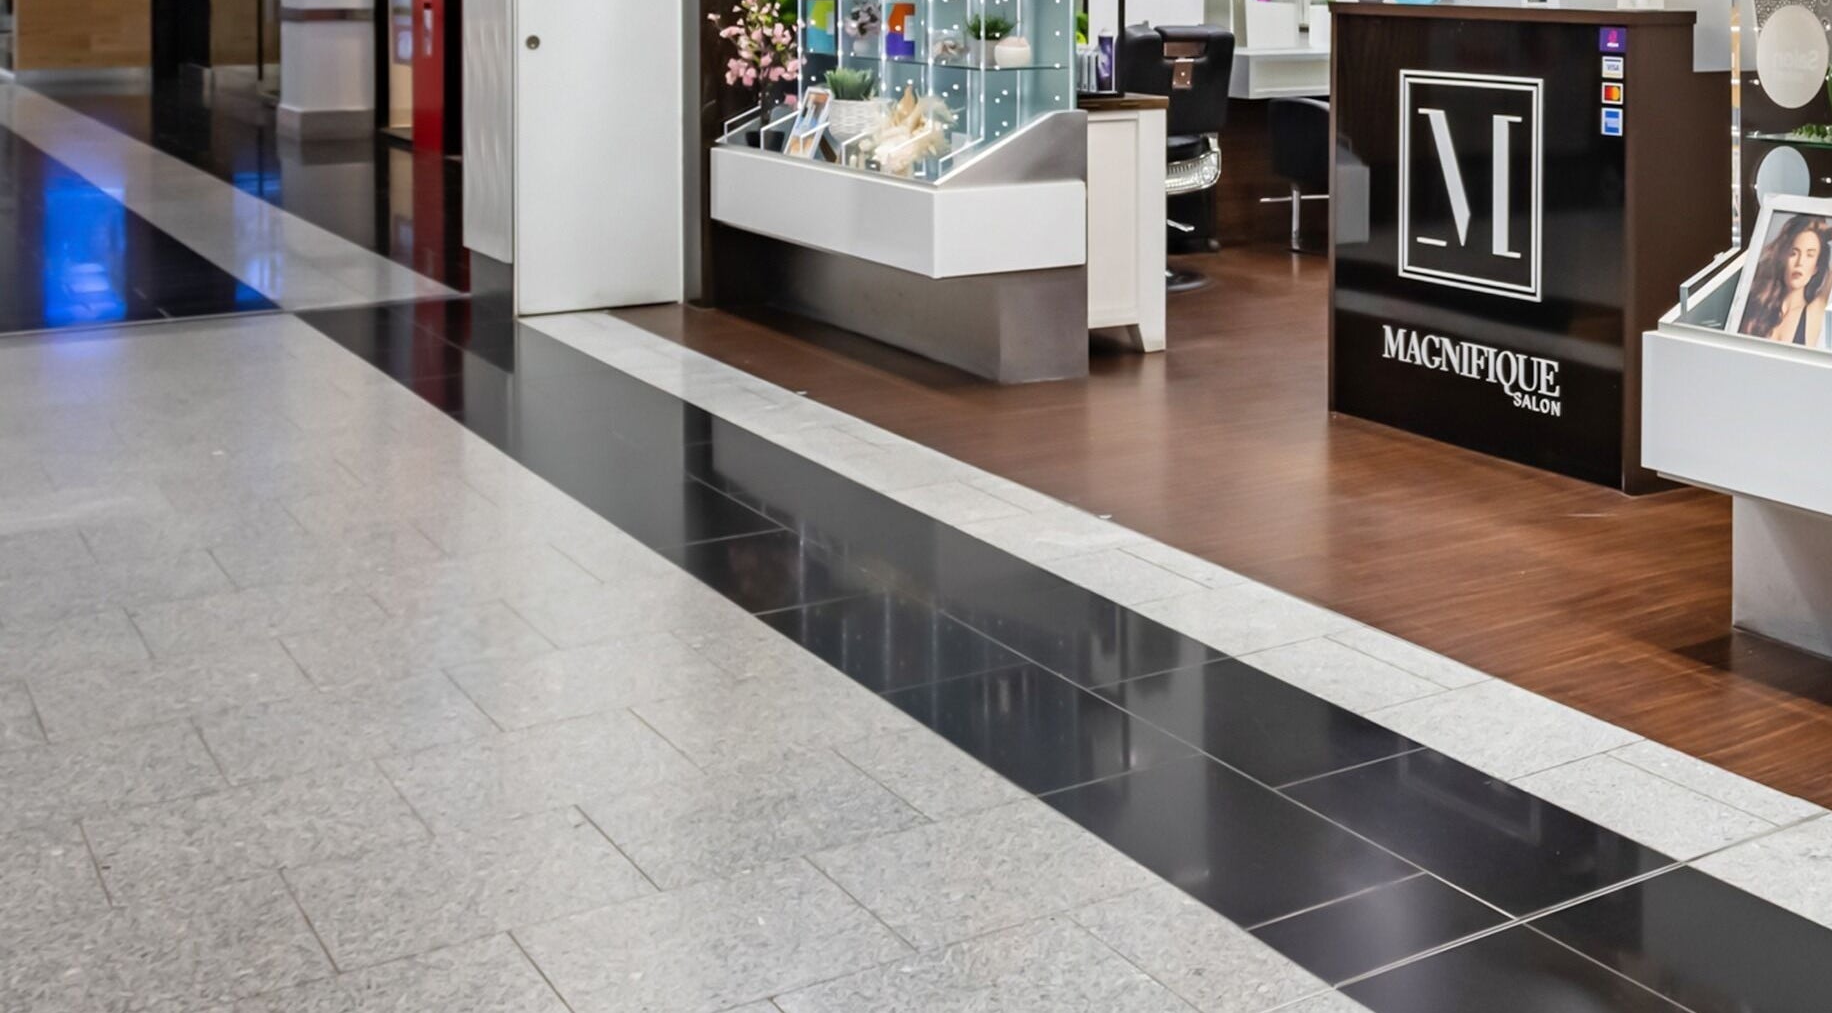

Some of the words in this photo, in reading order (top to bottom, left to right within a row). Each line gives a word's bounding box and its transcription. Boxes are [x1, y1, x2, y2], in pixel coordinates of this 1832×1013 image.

[1416, 108, 1523, 259] M
[1382, 325, 1560, 397] MAGNIFIQUE
[1513, 392, 1561, 417] SALON
